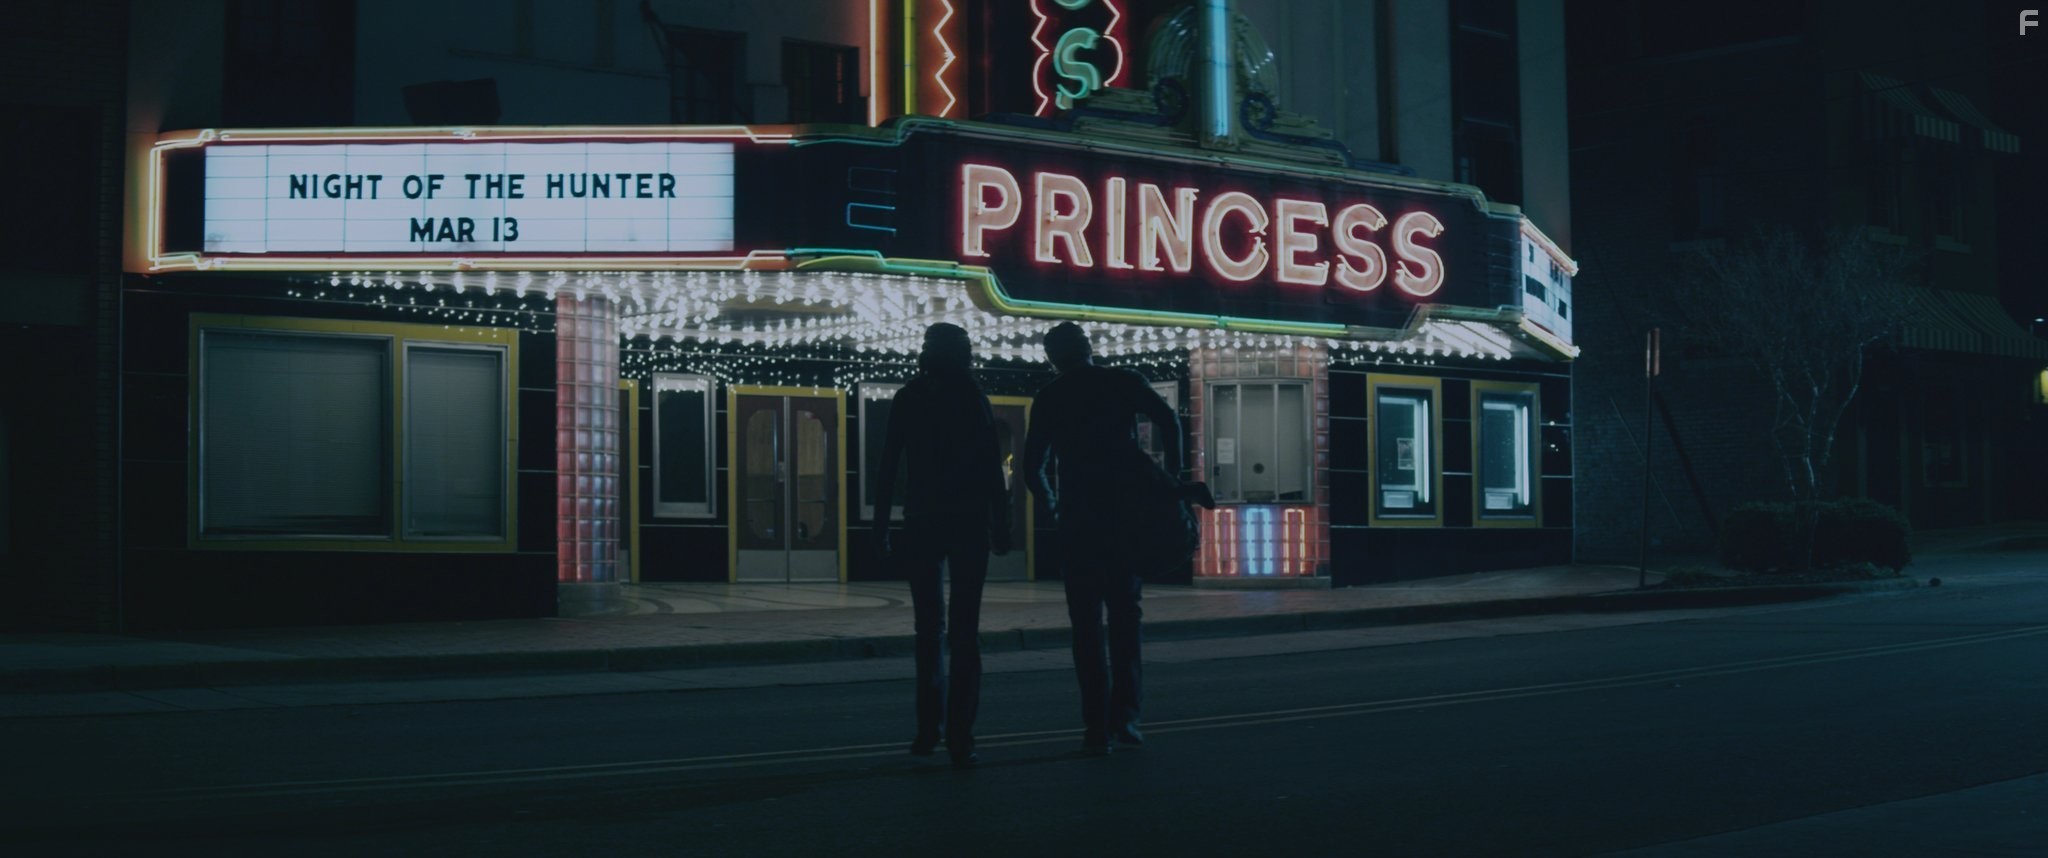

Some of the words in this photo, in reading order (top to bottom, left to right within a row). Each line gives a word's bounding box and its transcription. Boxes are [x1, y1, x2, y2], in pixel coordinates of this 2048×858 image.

[289, 174, 383, 200] NIGHT
[403, 174, 445, 200] OF
[465, 173, 526, 200] THE
[546, 173, 676, 200] HUNTER
[409, 217, 476, 243] MAR
[492, 216, 519, 242] 13
[962, 163, 1446, 298] PRINCESS
